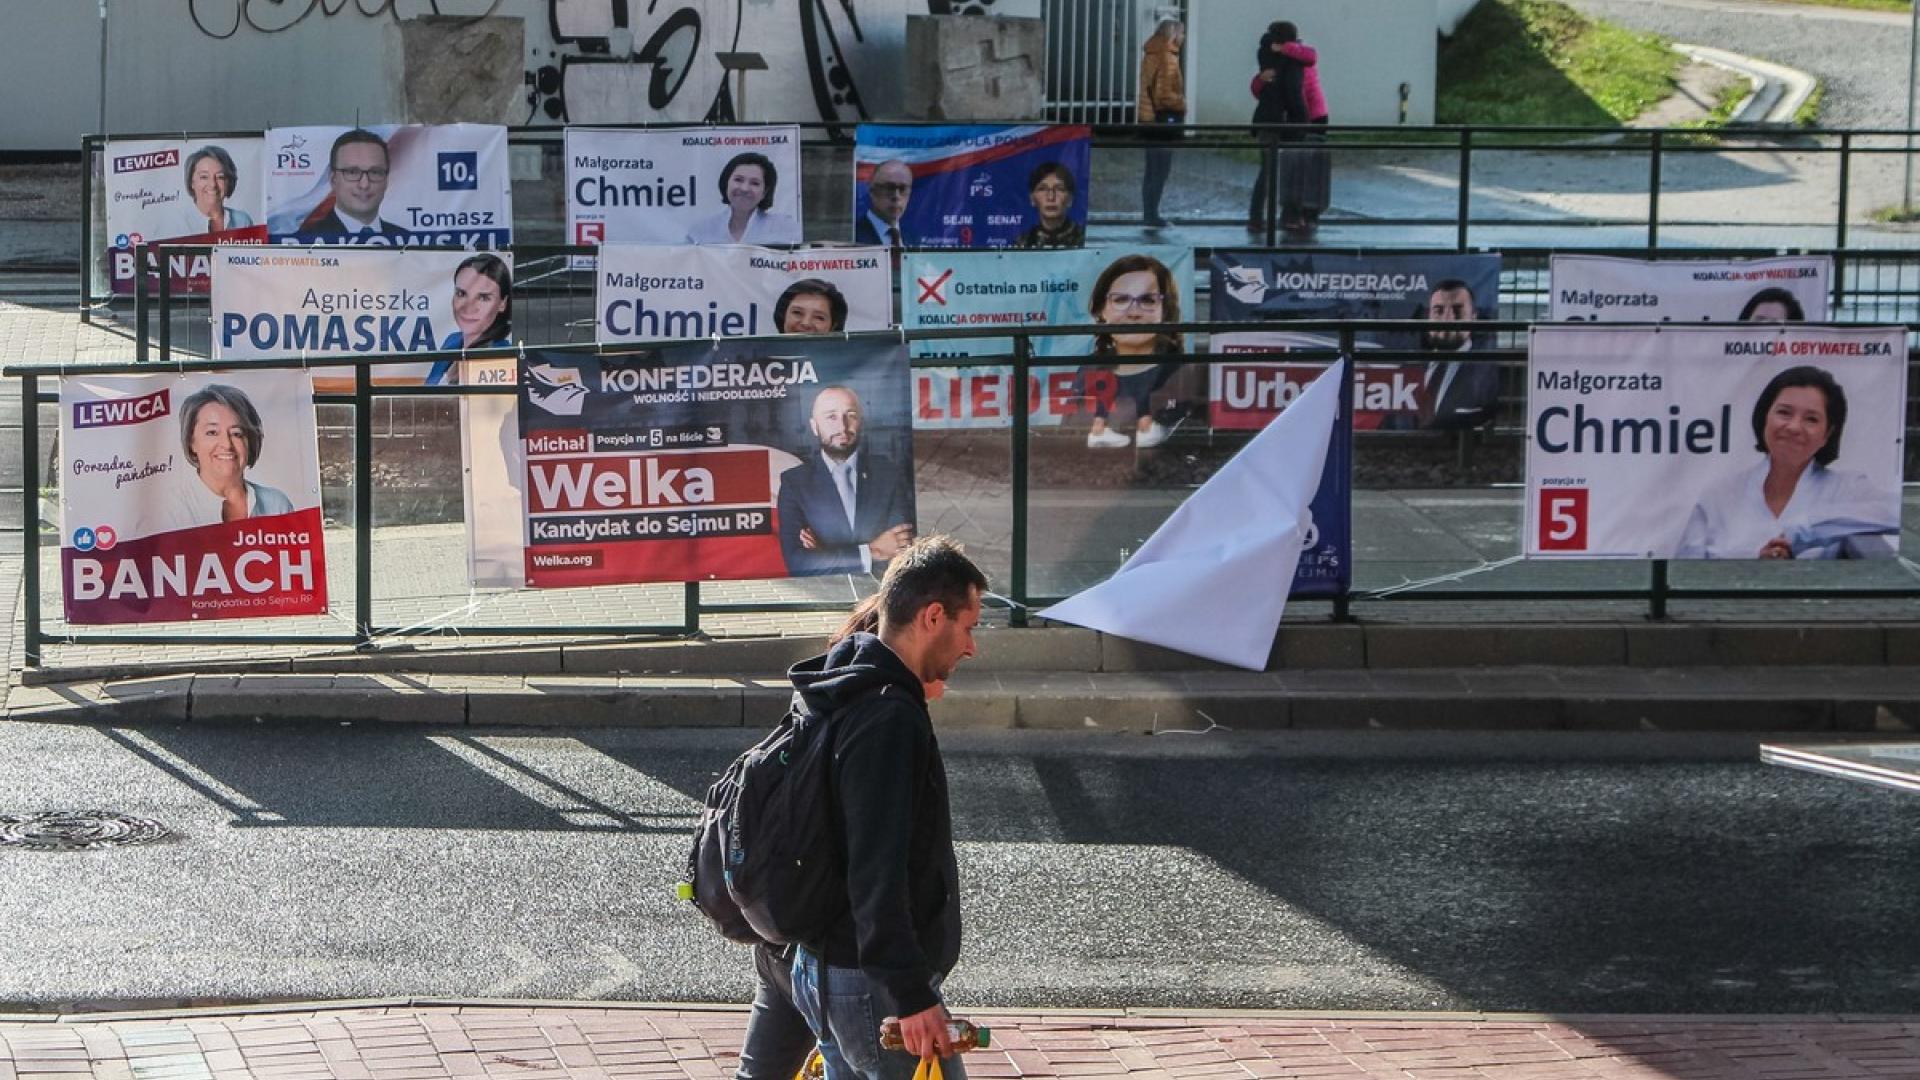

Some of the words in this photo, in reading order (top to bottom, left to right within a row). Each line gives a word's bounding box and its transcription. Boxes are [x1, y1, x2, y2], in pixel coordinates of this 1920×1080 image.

[682, 137, 724, 146] KOALICJA
[117, 152, 177, 171] LEWICA
[277, 151, 311, 169] PiS
[575, 155, 654, 171] Małgorzata
[441, 162, 475, 182] 10.
[575, 176, 696, 207] Chmiel
[406, 207, 494, 227] Tomasz
[944, 215, 973, 225] SEJM
[987, 215, 1023, 225] SENAT
[228, 256, 270, 266] KOALICJA
[272, 257, 339, 266] OBYWATELSKA
[750, 257, 797, 272] KOALICJA
[800, 258, 878, 271] OBYWATELSKA
[606, 272, 704, 291] Małgorzata
[955, 281, 1016, 296] Ostatnia
[1020, 284, 1038, 294] na
[1041, 280, 1079, 293] liście
[1276, 273, 1428, 290] KONFEDERACJA
[302, 288, 430, 314] Agnieszka
[1561, 289, 1659, 308] Małgorzata
[605, 299, 758, 337] Chmiel
[919, 312, 967, 325] KOALICJA
[970, 311, 1047, 324] OBYWATELSKA
[222, 312, 437, 352] POMASKA
[1725, 342, 1787, 355] KOALICJA
[1790, 341, 1892, 355] OBYWATELSKA
[602, 361, 818, 393] KONFEDERACJA
[1537, 371, 1662, 395] Małgorzata
[634, 391, 689, 405] WOLNOŚĆ
[698, 385, 787, 402] NIEPODLEGŁOŚĆ
[1226, 371, 1419, 410] Urbiak
[79, 395, 165, 424] LEWICA
[1536, 404, 1732, 453] Chmiel
[529, 436, 585, 452] Michał
[597, 433, 634, 446] Pozycja
[636, 435, 647, 443] nr
[665, 435, 678, 443] na
[73, 455, 133, 475] Porządne
[530, 459, 715, 509] Welka
[1542, 477, 1574, 486] pozycja
[533, 518, 630, 542] Kandydat
[636, 517, 662, 534] do
[667, 515, 730, 537] Sejmu
[736, 513, 765, 530] RP
[1549, 498, 1577, 541] 5
[233, 530, 310, 546] Jolanta
[533, 553, 593, 568] Welka.org
[73, 550, 313, 600] BANACH
[253, 598, 266, 606] do
